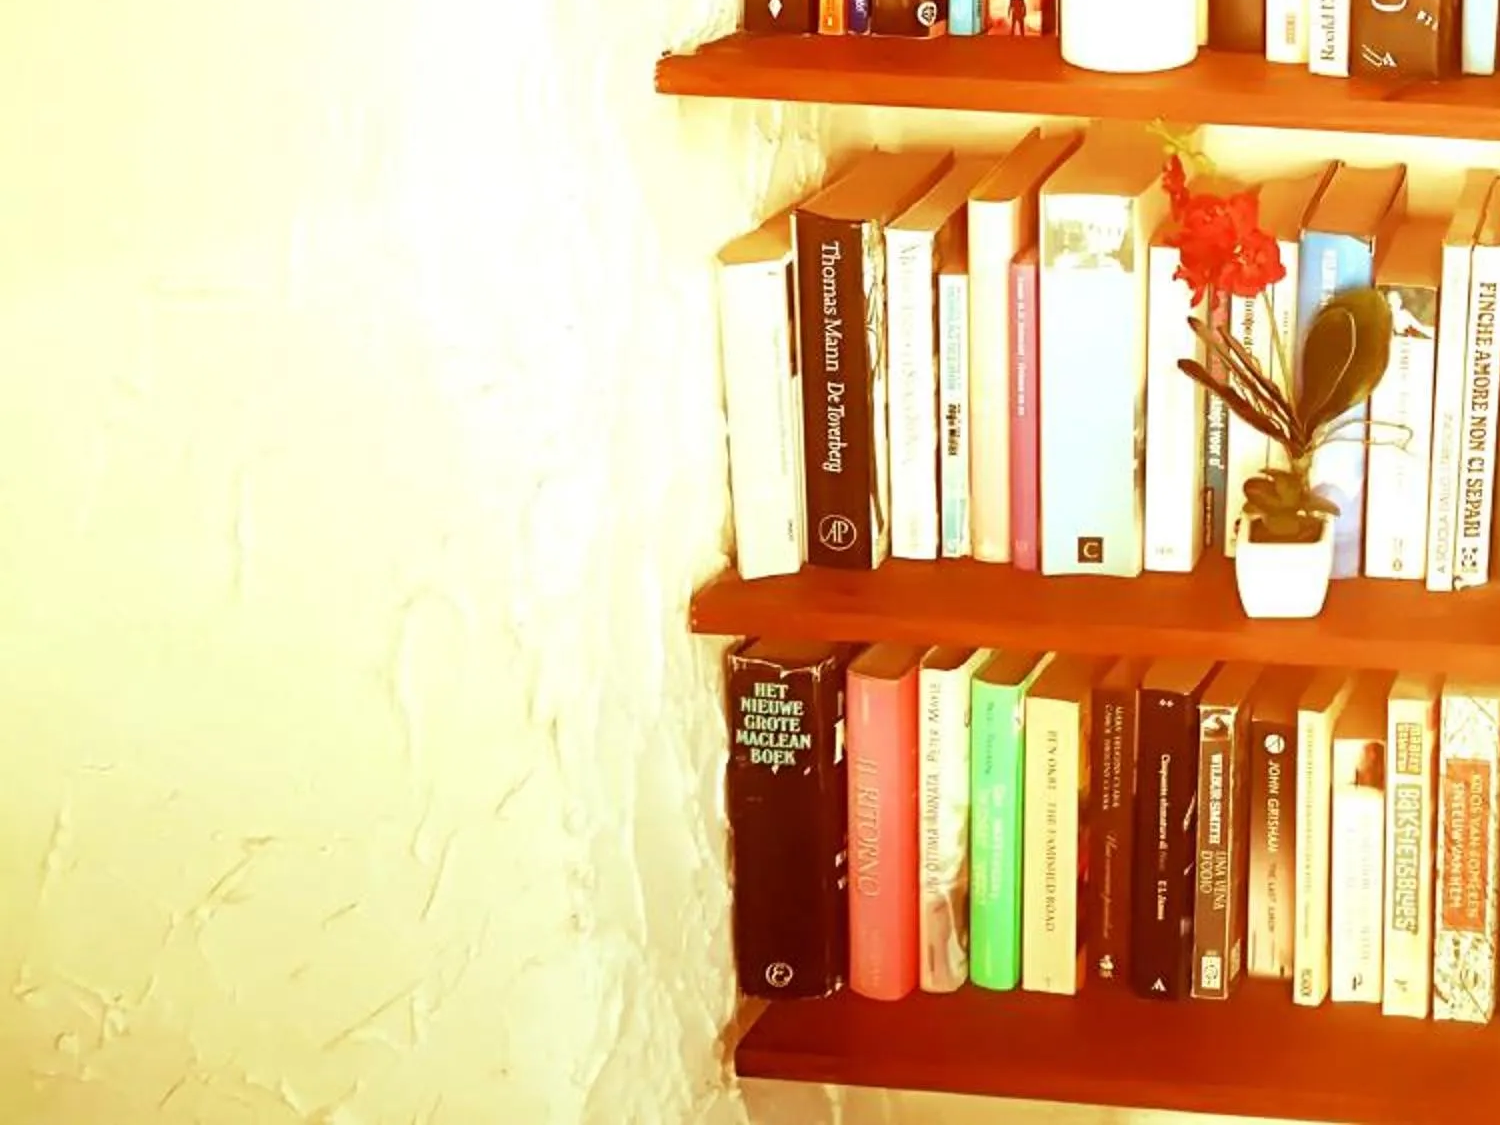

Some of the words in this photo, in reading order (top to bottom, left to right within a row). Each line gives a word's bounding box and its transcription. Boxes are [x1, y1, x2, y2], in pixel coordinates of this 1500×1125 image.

[820, 241, 840, 315] Thomas
[823, 319, 843, 372] Mann
[826, 381, 845, 402] De
[1473, 349, 1492, 412] AMORE
[821, 405, 847, 474] Toverberg
[1469, 416, 1488, 451] NON
[1467, 456, 1485, 474] CI
[1463, 477, 1483, 538] SEPARI
[740, 695, 807, 717] NIEUWE
[753, 681, 790, 700] HET
[737, 730, 813, 751] MACLEAN
[743, 714, 803, 734] GROTE
[749, 747, 798, 767] BOEK
[1267, 759, 1281, 795] JOHN
[925, 773, 941, 825] ANNATA
[1046, 802, 1057, 826] THE
[855, 783, 882, 898] RITORNO
[1266, 798, 1281, 853] GRISHAM
[1469, 817, 1481, 848] VAN
[1212, 850, 1228, 875] UNA
[1045, 896, 1056, 933] ROAD
